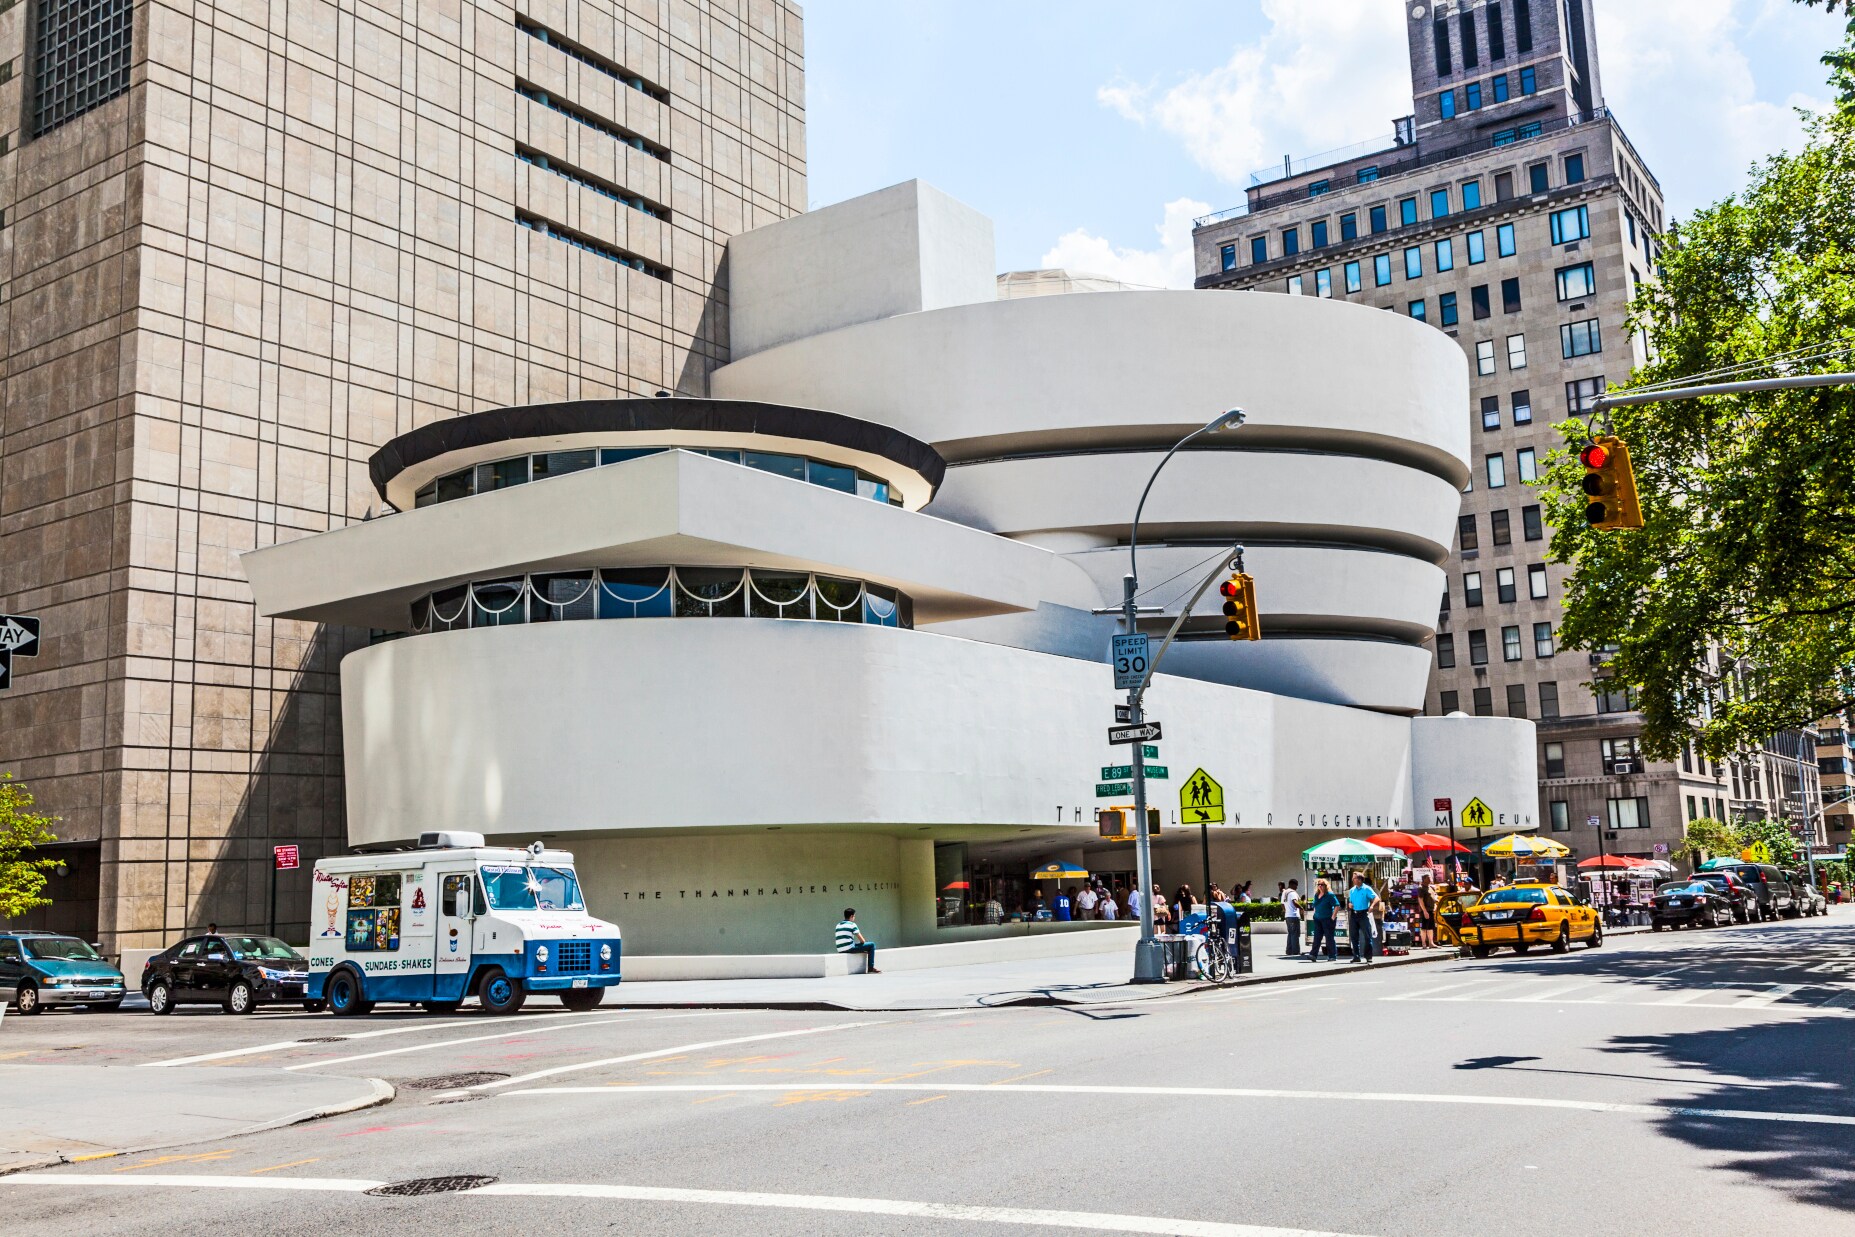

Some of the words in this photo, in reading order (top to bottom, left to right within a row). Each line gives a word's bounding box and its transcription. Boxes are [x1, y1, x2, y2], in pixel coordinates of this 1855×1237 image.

[0, 628, 24, 643] AY
[1115, 638, 1146, 647] SPEED
[1118, 647, 1143, 656] LIMIT
[1118, 656, 1146, 673] 30
[1119, 710, 1128, 718] ONE
[1115, 731, 1131, 740] ONE
[1140, 728, 1155, 737] WAY
[1104, 768, 1109, 779] E
[1112, 767, 1122, 777] 89
[1096, 784, 1110, 792] FRED
[1056, 805, 1100, 823] THE
[1297, 813, 1400, 828] GUGGENHEIM
[1435, 813, 1531, 827] MEUM
[623, 891, 662, 900] THE
[680, 884, 827, 899] THANNHAUSER
[1060, 898, 1069, 907] 10
[310, 957, 334, 967] CONES
[365, 960, 397, 971] SUNDAES
[401, 958, 432, 969] SHAKES
